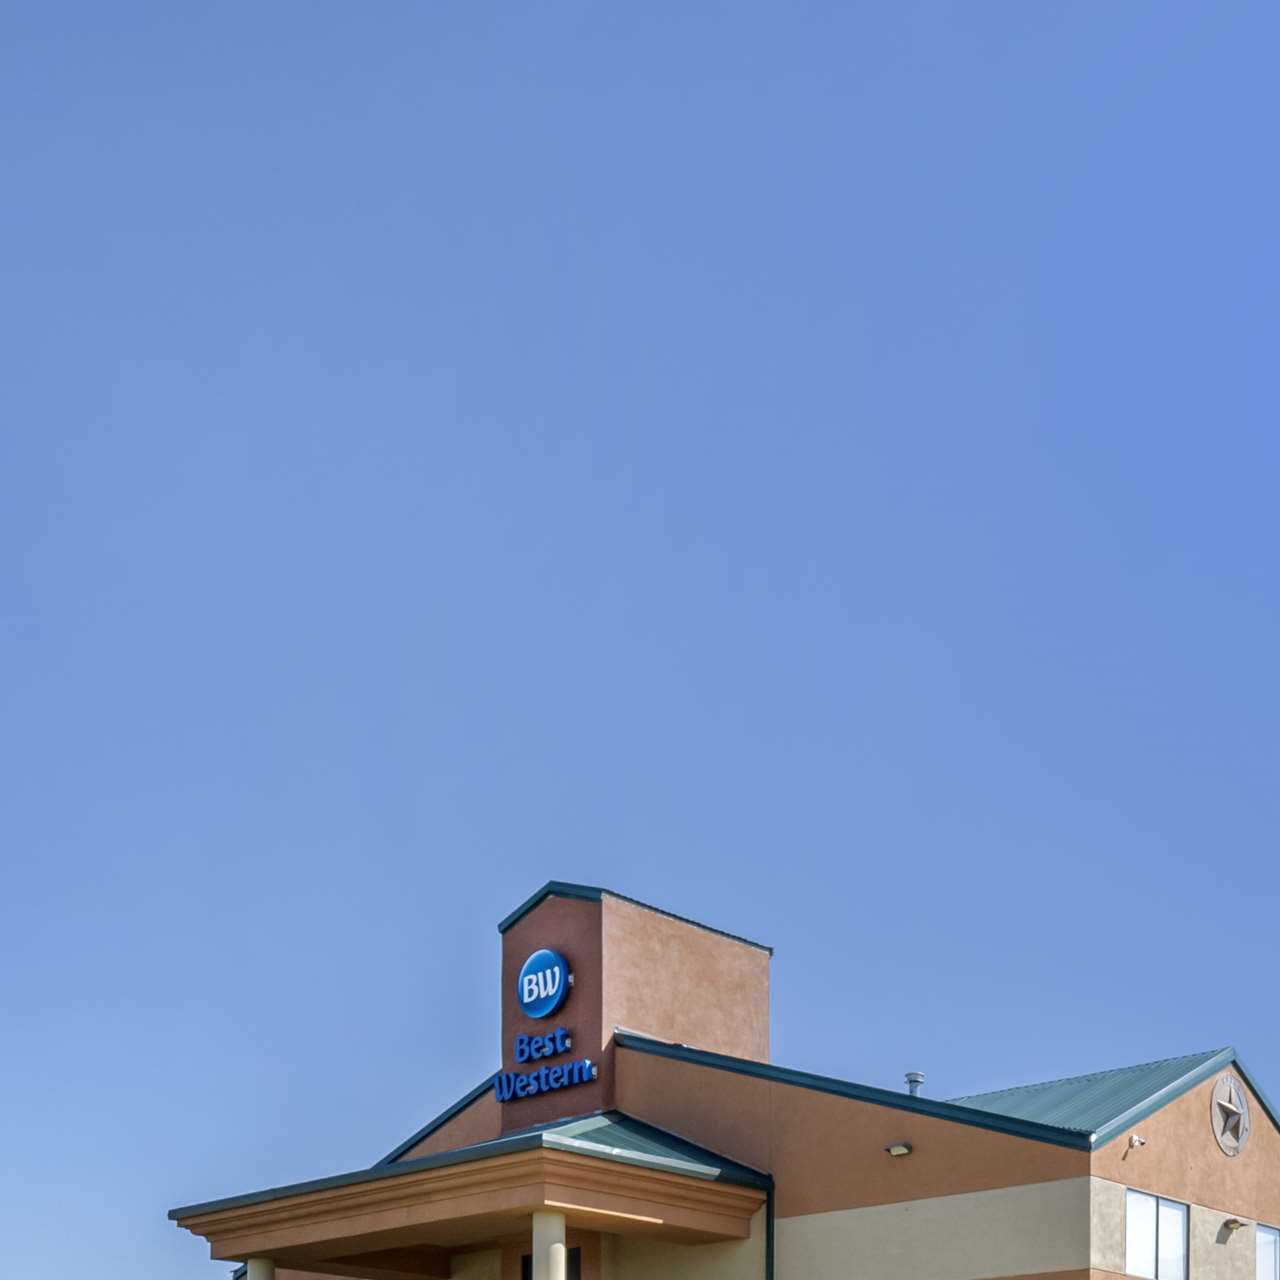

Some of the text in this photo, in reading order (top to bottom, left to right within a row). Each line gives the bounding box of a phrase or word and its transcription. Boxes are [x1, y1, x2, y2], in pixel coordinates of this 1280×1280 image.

[522, 966, 560, 1004] BW
[514, 1026, 568, 1063] Best
[494, 1058, 593, 1103] Western
